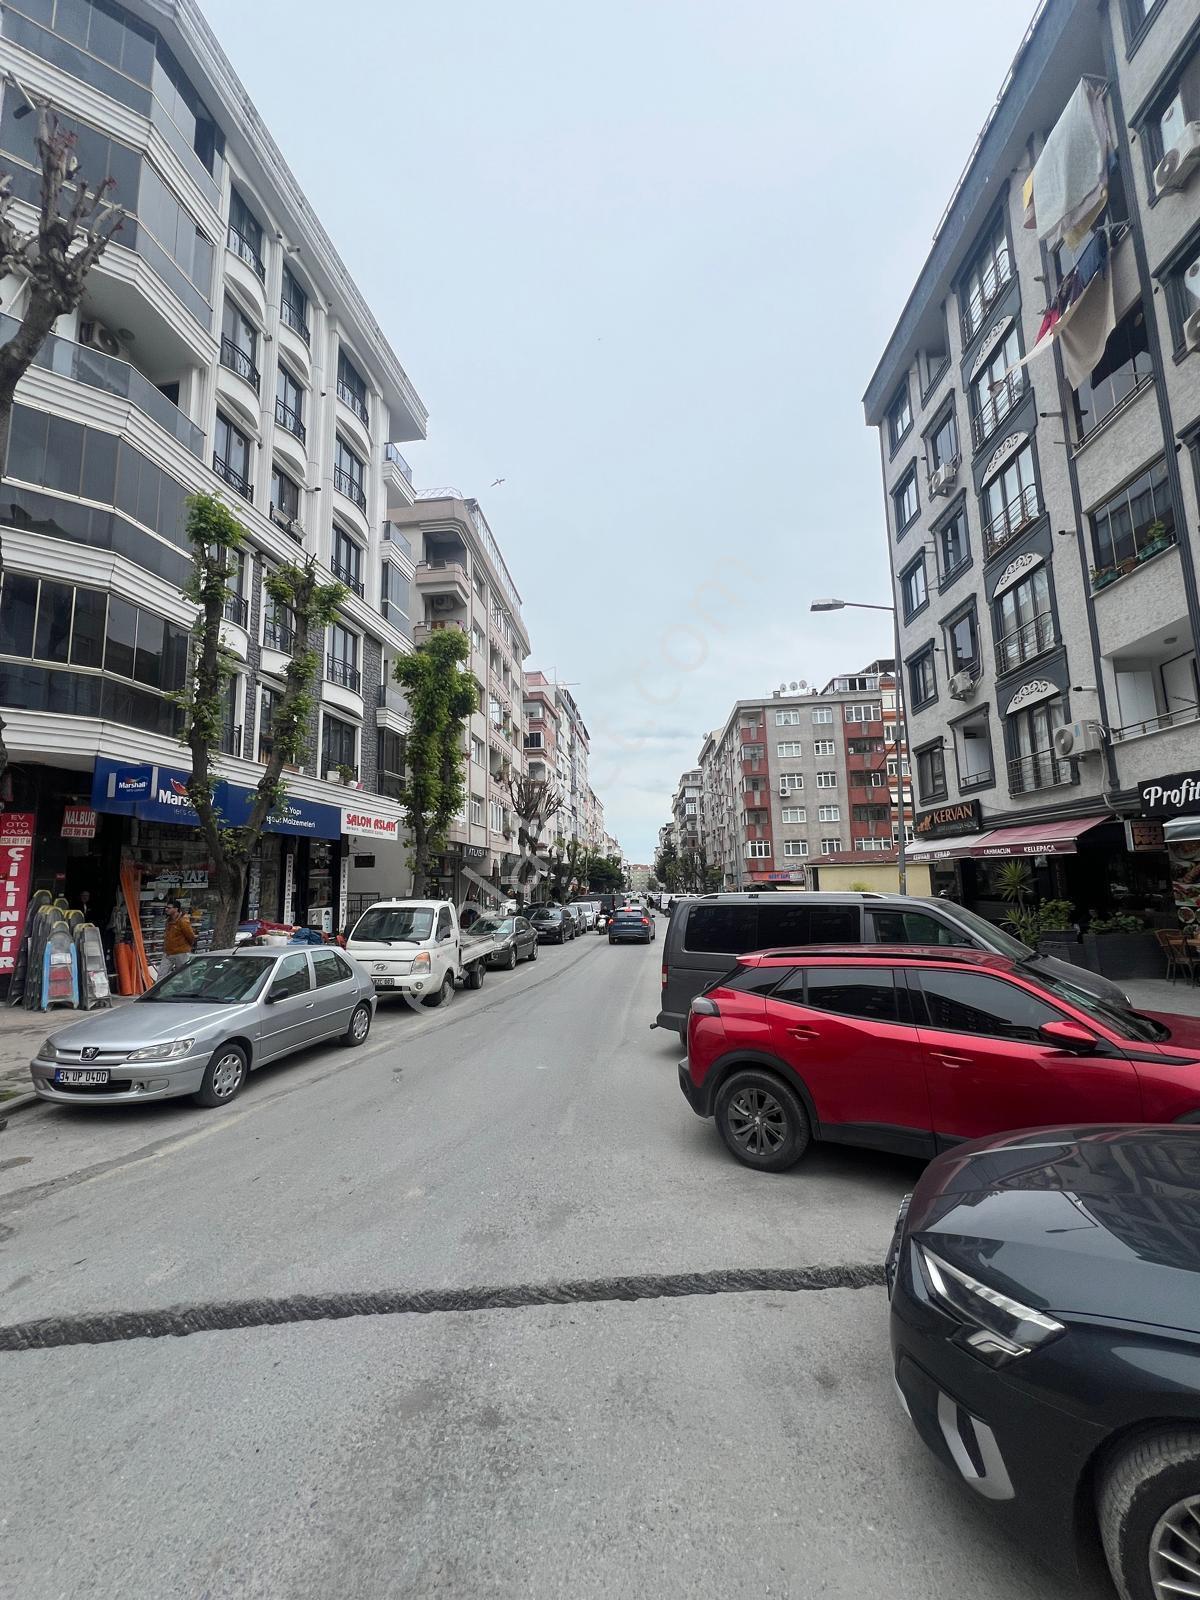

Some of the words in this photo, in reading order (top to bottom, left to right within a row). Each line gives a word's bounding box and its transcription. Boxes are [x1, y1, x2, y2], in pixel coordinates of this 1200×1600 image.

[118, 780, 146, 789] Marshall
[64, 810, 96, 826] NALBUR
[933, 804, 973, 824] KERVAN
[282, 817, 316, 828] Malzemeleri
[346, 813, 372, 828] SALON
[374, 818, 396, 832] ASLAN
[60, 1071, 69, 1081] 34
[72, 1071, 83, 1081] UP
